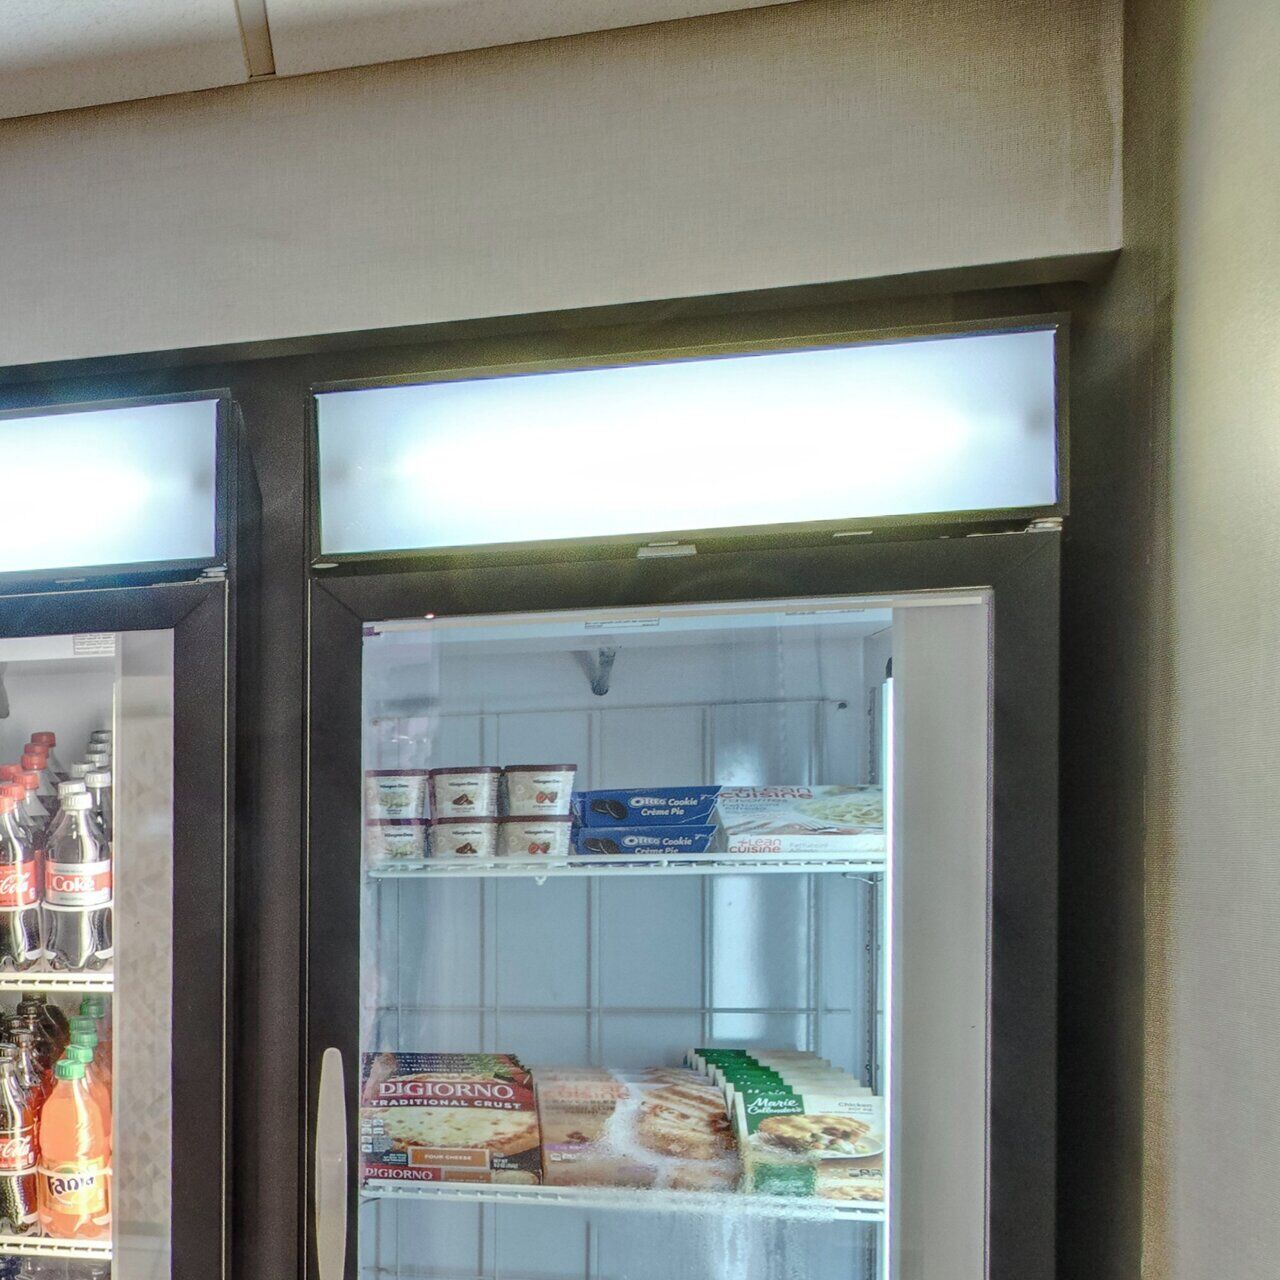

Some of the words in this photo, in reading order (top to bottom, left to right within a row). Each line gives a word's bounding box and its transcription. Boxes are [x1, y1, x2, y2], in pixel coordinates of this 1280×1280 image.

[630, 796, 666, 808] OREO
[668, 797, 698, 808] Cookie
[641, 806, 668, 817] Crème
[669, 807, 685, 817] Pie
[624, 835, 660, 847] OREO
[662, 837, 693, 847] Cookie
[52, 876, 96, 893] Coke
[379, 1082, 515, 1099] DIGIORNO
[371, 1099, 469, 1107] TRADITIONAL
[474, 1100, 523, 1110] CRUST
[747, 1097, 800, 1108] Marie
[747, 1105, 803, 1115] Callender's
[365, 1167, 433, 1180] DIGIORNO
